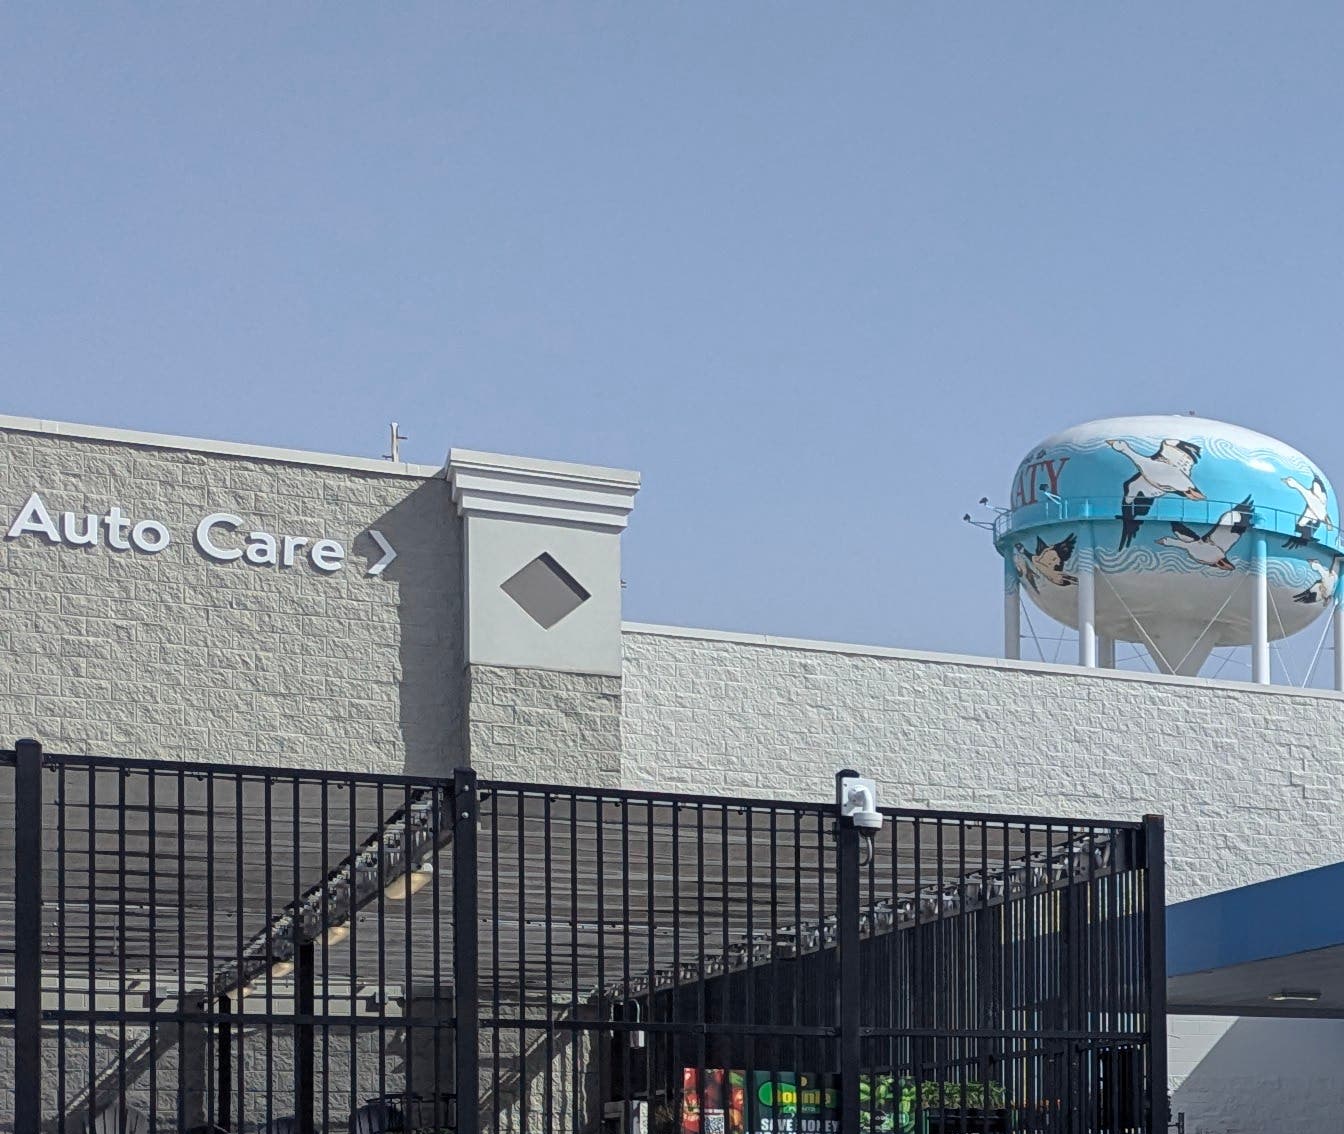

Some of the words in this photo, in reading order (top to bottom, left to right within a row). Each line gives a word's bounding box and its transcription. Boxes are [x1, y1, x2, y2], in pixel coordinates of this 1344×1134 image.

[1014, 457, 1071, 507] ATY
[7, 491, 171, 553] Auto
[196, 512, 347, 572] Care
[760, 1118, 793, 1131] SVE
